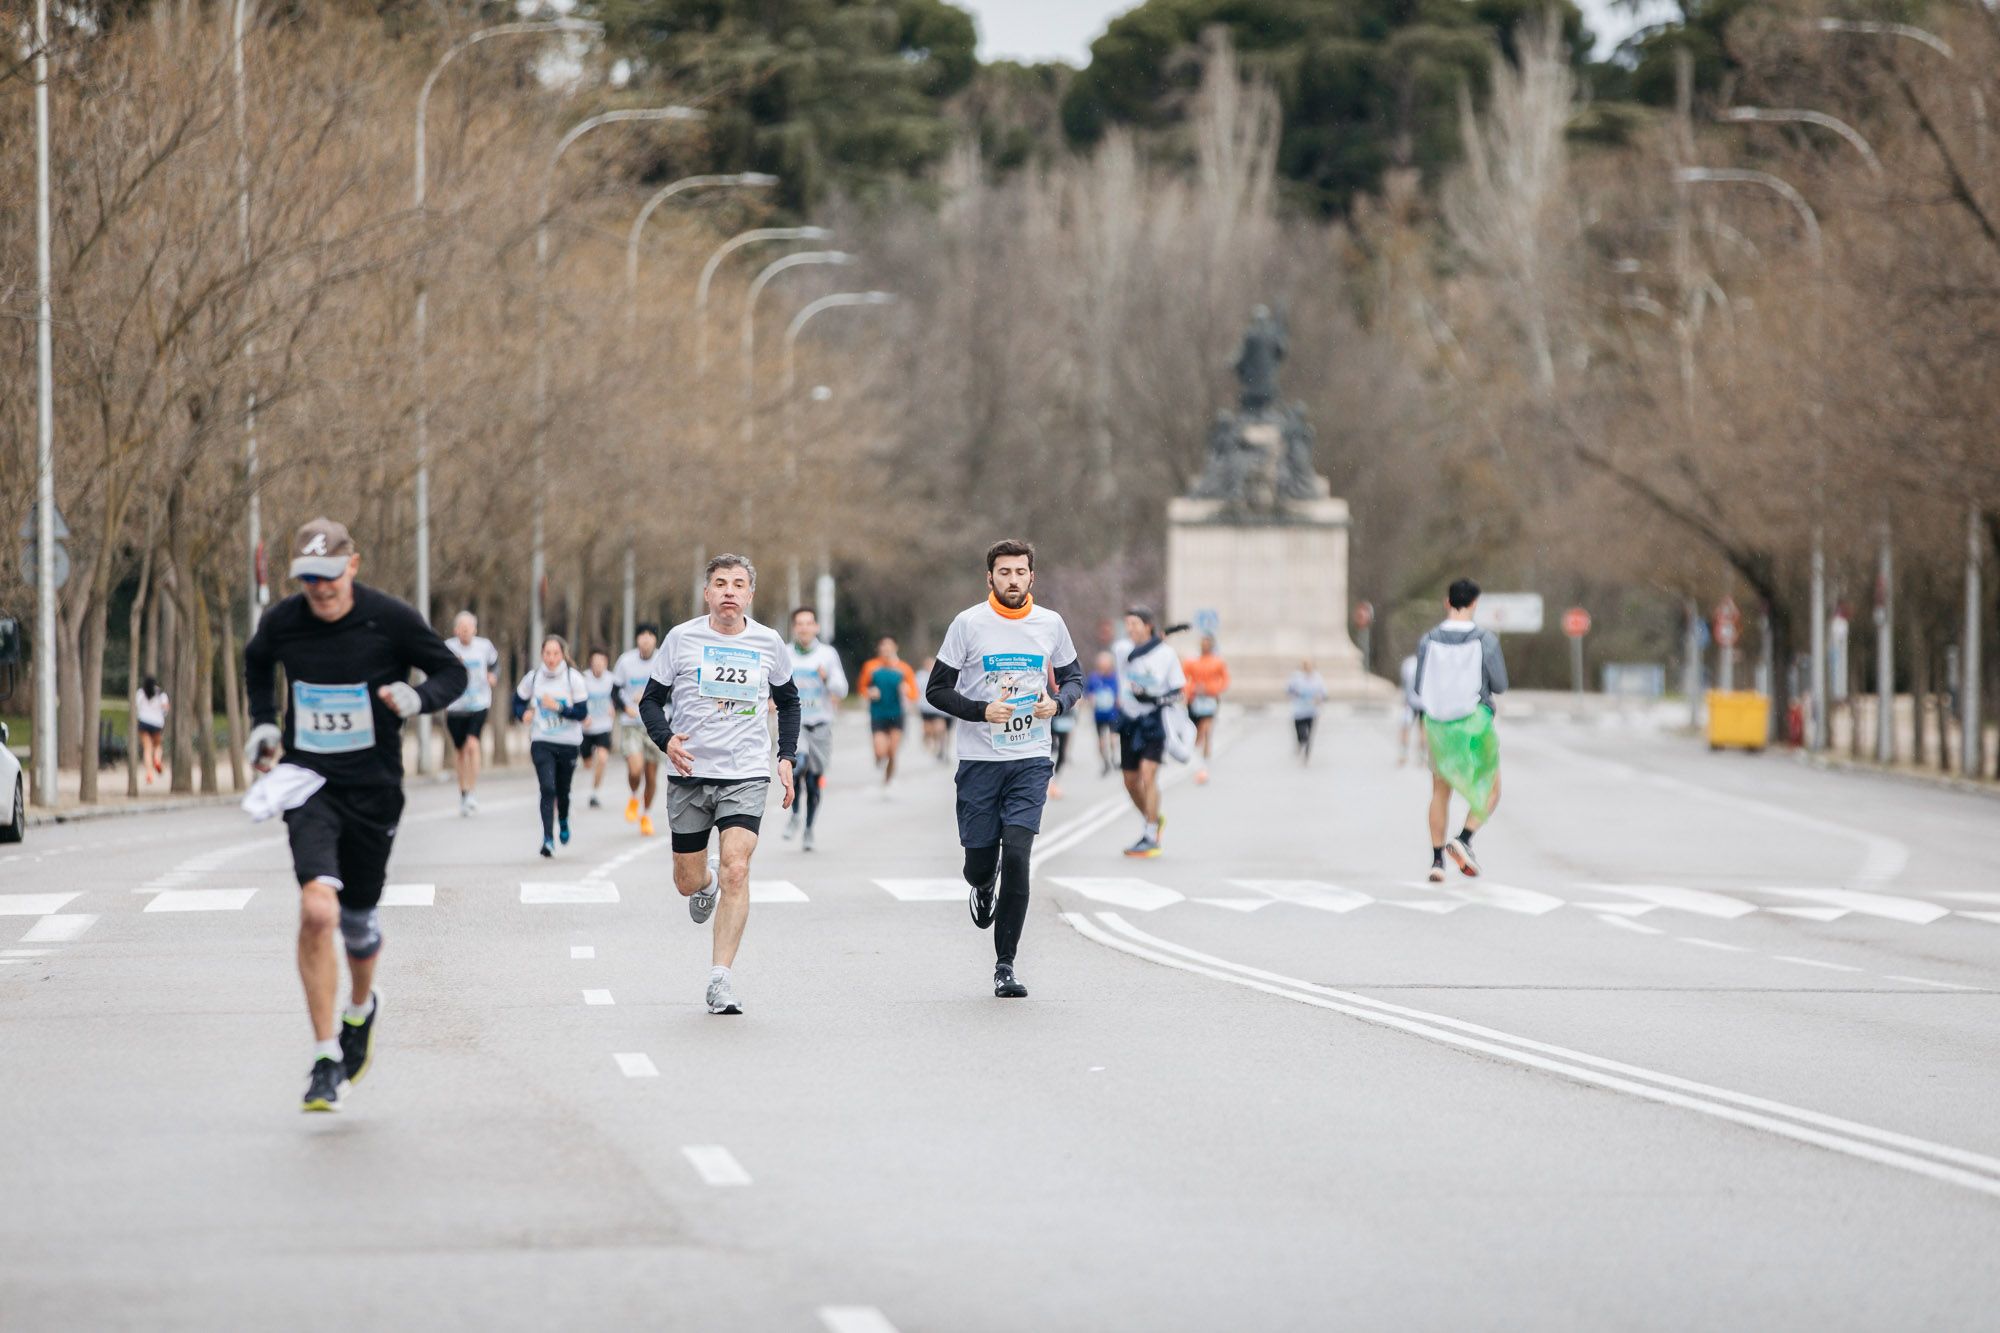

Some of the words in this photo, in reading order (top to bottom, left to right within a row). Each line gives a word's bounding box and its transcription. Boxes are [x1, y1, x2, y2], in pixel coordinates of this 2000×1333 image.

[714, 666, 747, 684] 223
[312, 712, 352, 731] 133
[1004, 714, 1033, 732] 109
[1009, 733, 1025, 741] 0117
